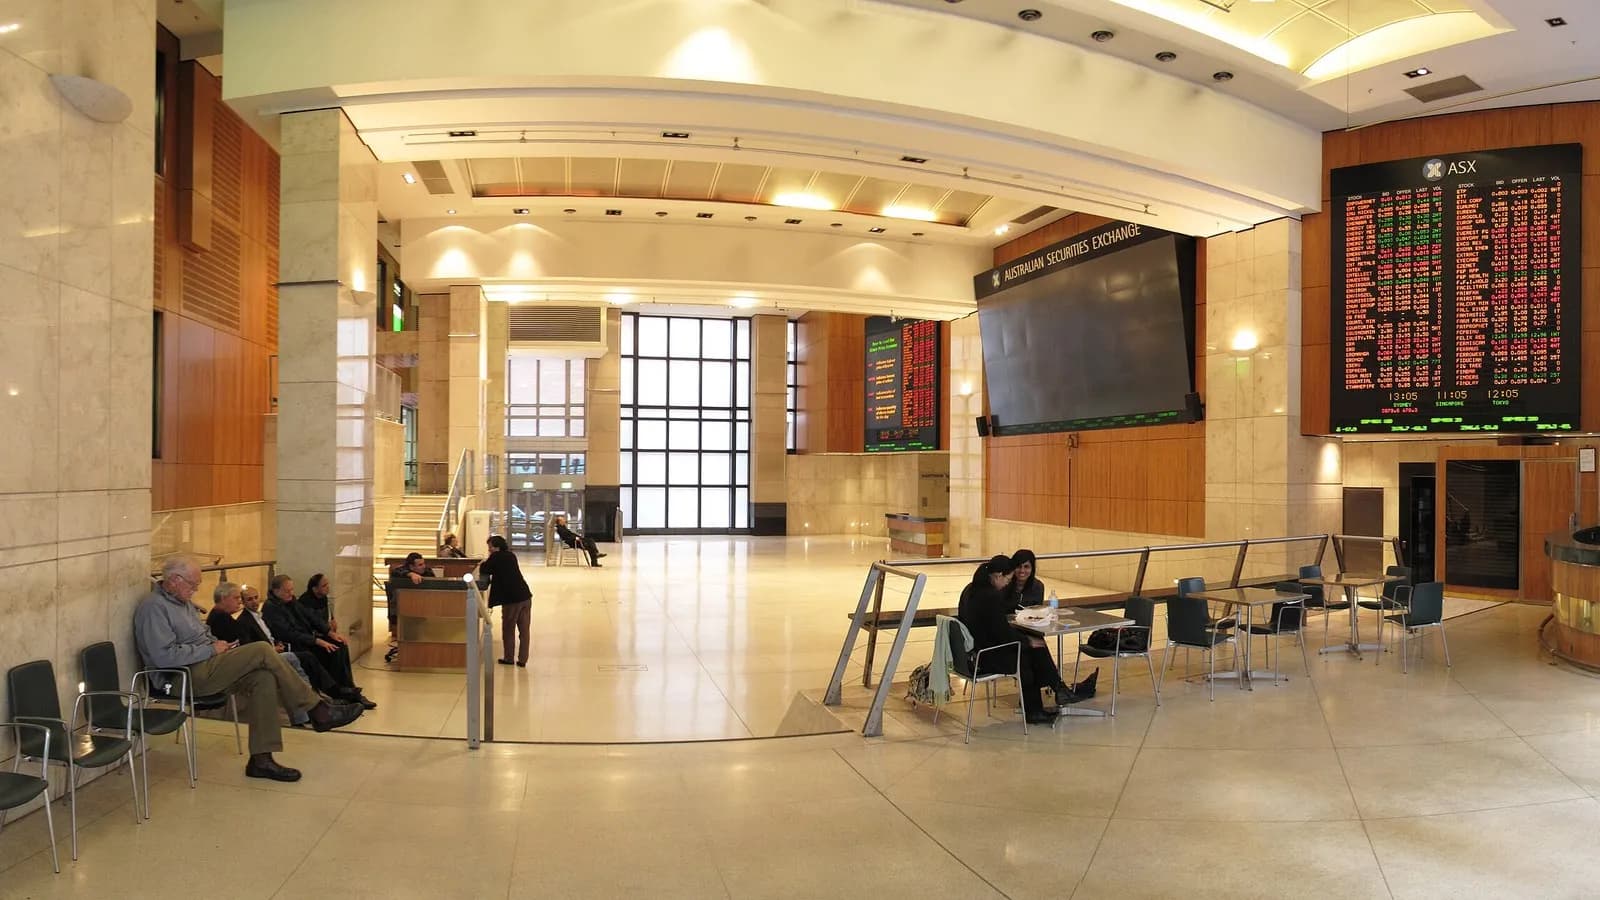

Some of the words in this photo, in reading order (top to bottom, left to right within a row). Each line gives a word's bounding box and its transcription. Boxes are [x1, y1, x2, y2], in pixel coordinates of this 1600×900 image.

[1448, 160, 1477, 174] ASX
[1004, 255, 1044, 282] AUSTRALIAN
[1047, 240, 1090, 266] SECURITIES
[1092, 223, 1142, 250] EXCHANGE
[1389, 392, 1418, 400] 13:05
[1438, 390, 1468, 400] 11:05
[1488, 389, 1519, 399] 12:05
